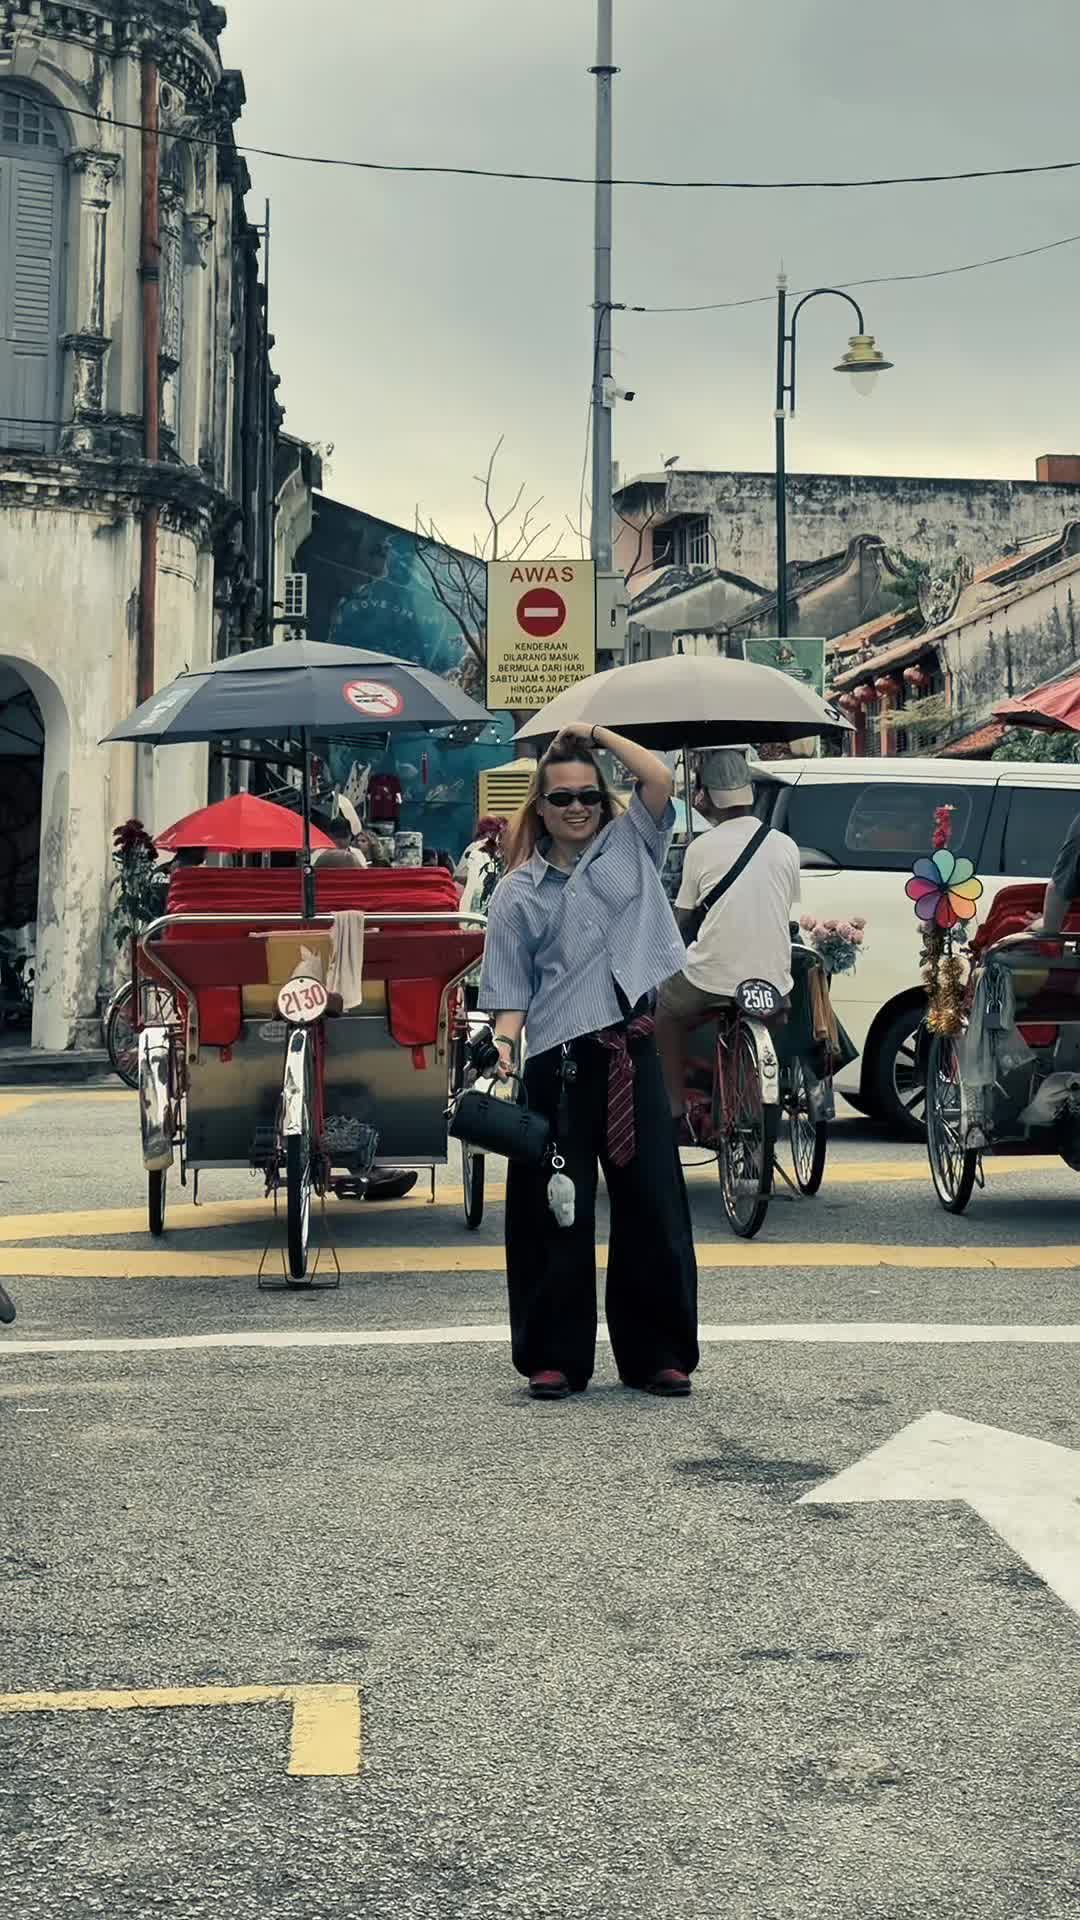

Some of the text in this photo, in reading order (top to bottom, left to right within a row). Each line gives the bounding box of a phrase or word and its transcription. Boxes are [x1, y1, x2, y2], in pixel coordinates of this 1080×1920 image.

[510, 566, 575, 583] AWAS
[514, 642, 568, 651] KENDERAAN
[503, 653, 580, 662] DILARANG MASUK
[498, 664, 585, 672] BERMULA DARI HARI
[489, 674, 519, 683] SABTU
[520, 674, 538, 683] JAM
[558, 673, 592, 683] PETAN
[510, 685, 544, 693] HINGGA
[504, 696, 522, 704] JAM
[524, 696, 545, 704] 10.30
[282, 984, 325, 1015] 2130
[743, 990, 774, 1008] 2516
